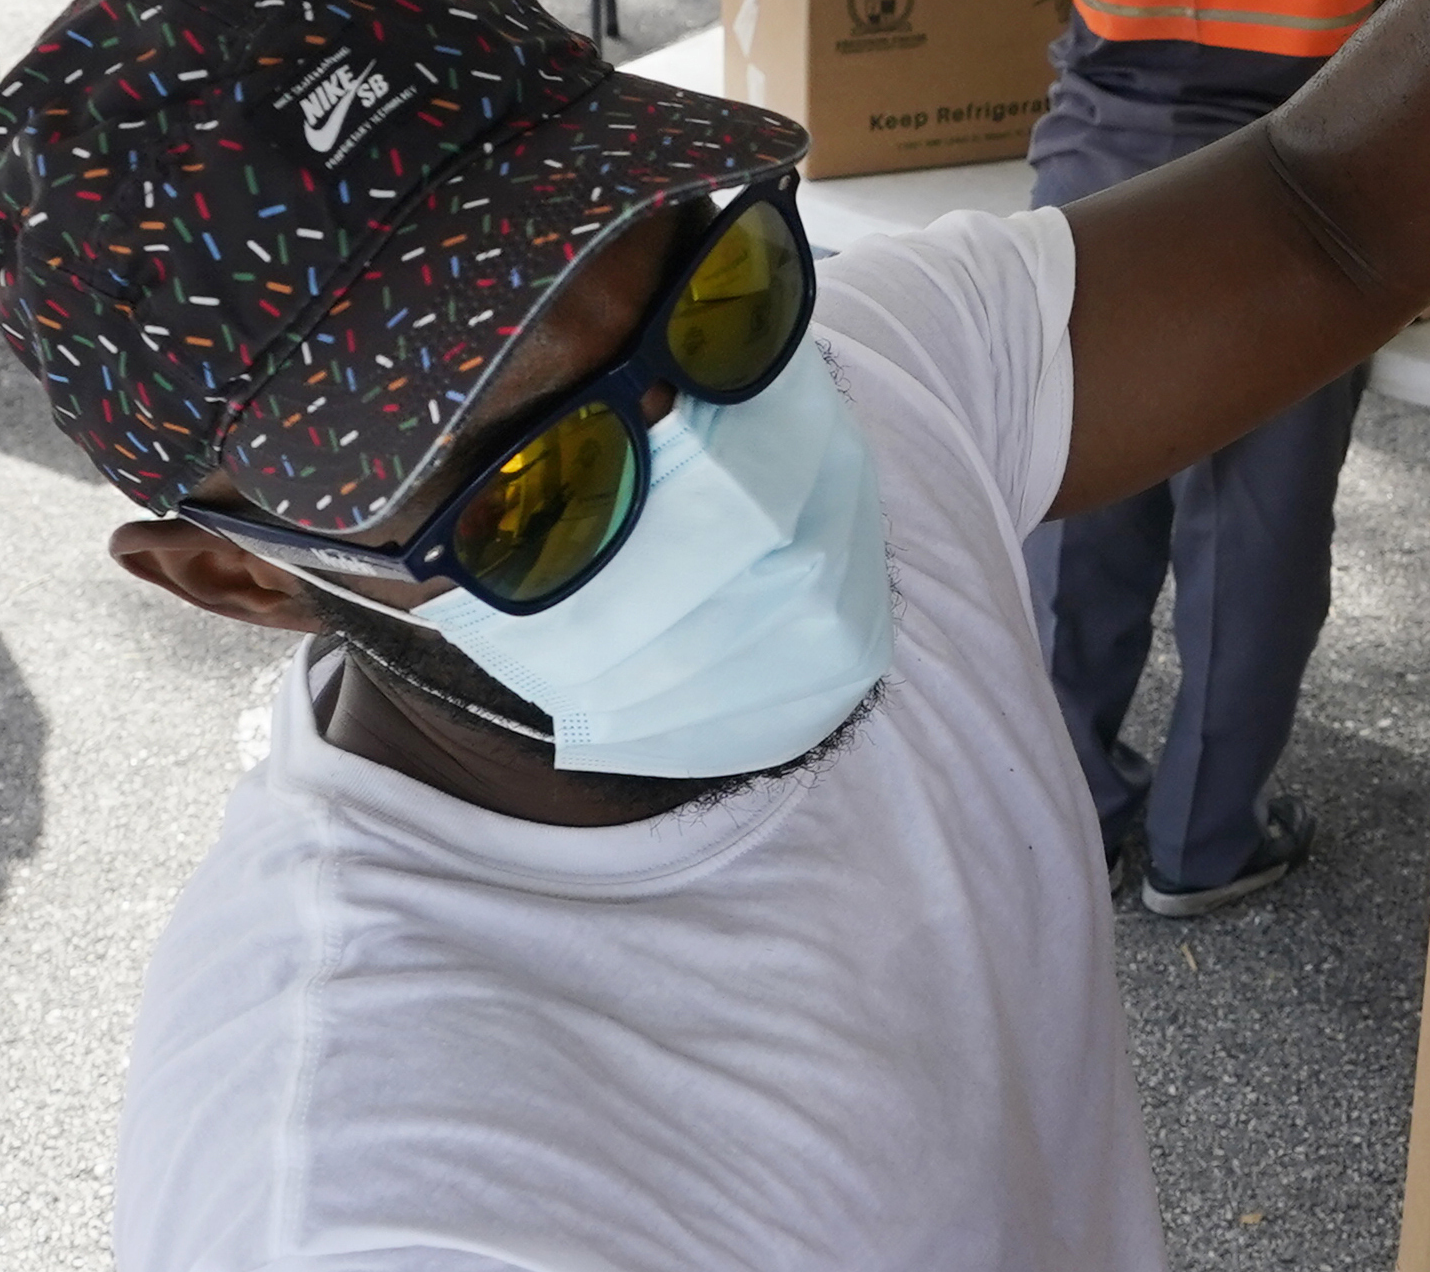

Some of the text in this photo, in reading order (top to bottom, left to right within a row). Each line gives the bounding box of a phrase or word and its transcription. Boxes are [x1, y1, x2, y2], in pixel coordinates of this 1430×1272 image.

[299, 64, 354, 126] NIKE
[357, 73, 389, 108] SB
[870, 96, 1050, 131] Keep Refrigerat
